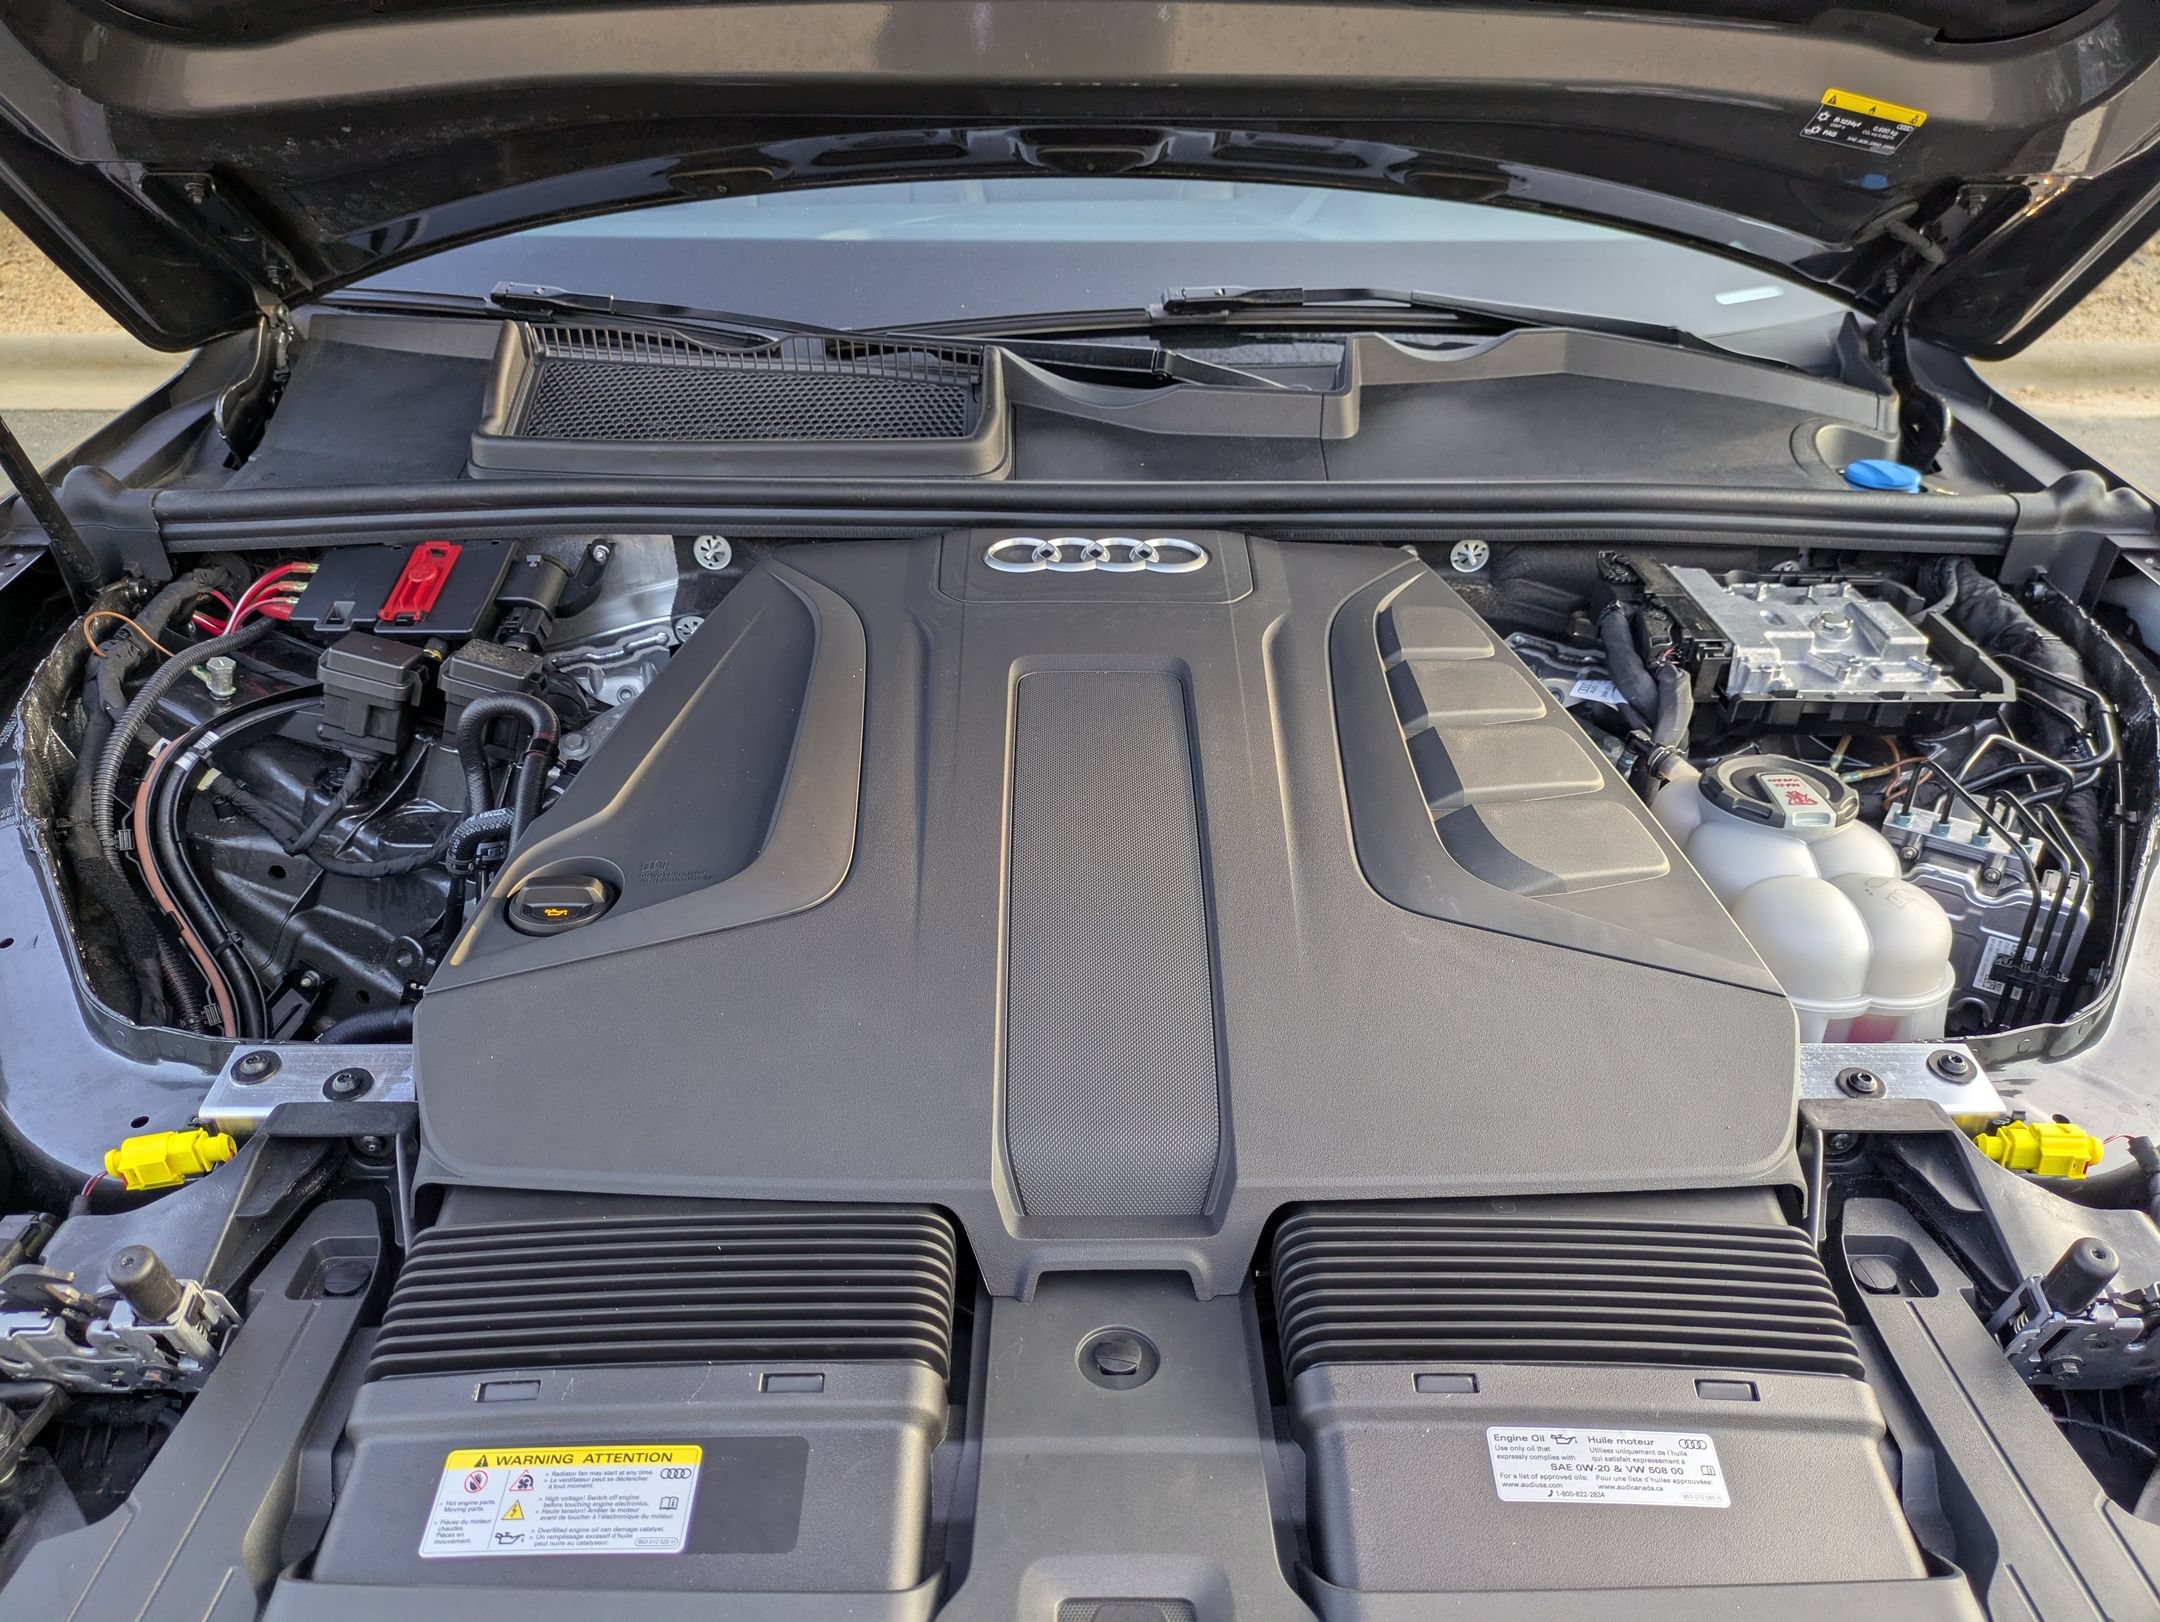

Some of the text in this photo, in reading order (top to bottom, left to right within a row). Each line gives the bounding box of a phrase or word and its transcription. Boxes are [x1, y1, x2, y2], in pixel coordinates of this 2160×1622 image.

[1493, 1434, 1528, 1443] Engine
[1587, 1436, 1613, 1444] Huile
[496, 1452, 672, 1466] WARNING ATTENTION
[1576, 1464, 1610, 1472] 0W-20
[1625, 1465, 1645, 1473] VW
